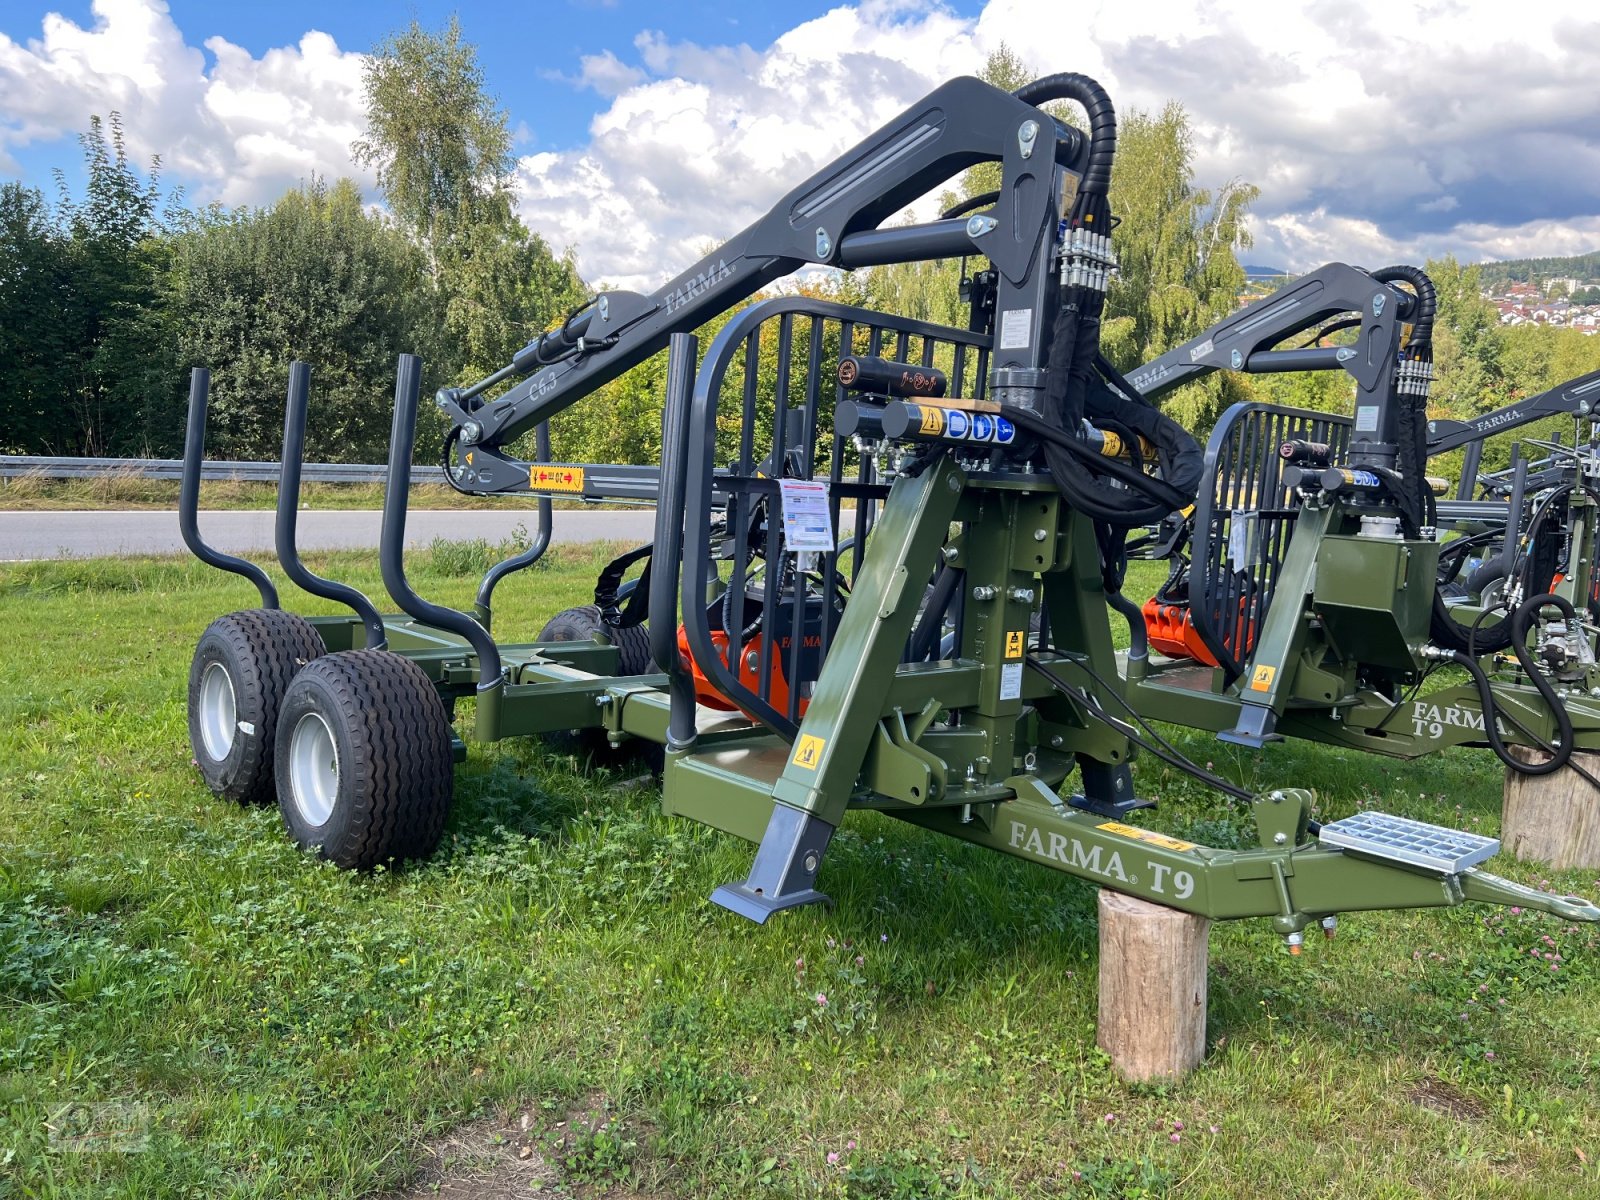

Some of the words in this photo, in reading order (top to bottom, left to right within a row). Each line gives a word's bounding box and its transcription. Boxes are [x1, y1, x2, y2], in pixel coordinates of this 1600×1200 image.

[664, 259, 731, 316] FARMA
[529, 372, 557, 401] C6.3
[1477, 410, 1520, 432] FARMA
[1411, 718, 1443, 739] T9
[1008, 820, 1129, 883] FARMA
[1147, 861, 1195, 900] T9
